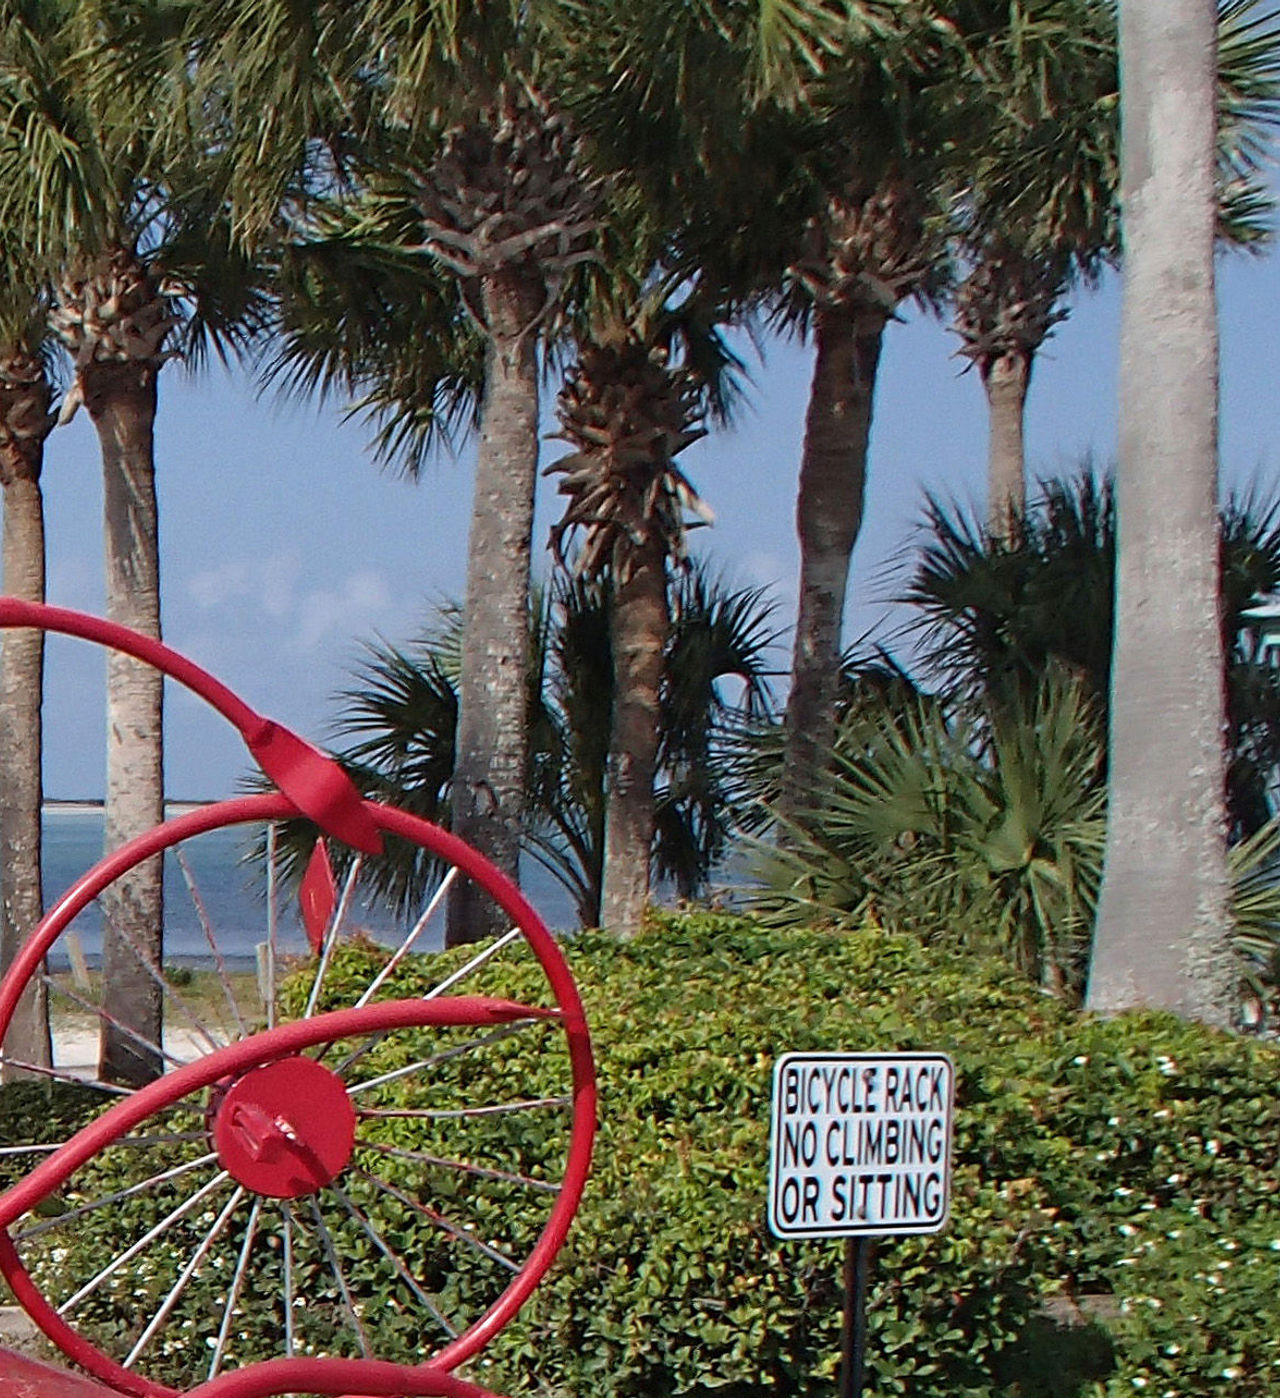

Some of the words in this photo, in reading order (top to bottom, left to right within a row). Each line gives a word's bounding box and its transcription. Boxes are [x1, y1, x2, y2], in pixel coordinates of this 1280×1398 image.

[785, 1067, 877, 1114] BICYCLE
[885, 1066, 943, 1112] RACK
[783, 1121, 817, 1168] NO
[826, 1118, 942, 1167] CLIMBING
[782, 1176, 820, 1223] OR
[830, 1172, 940, 1221] SITTING
